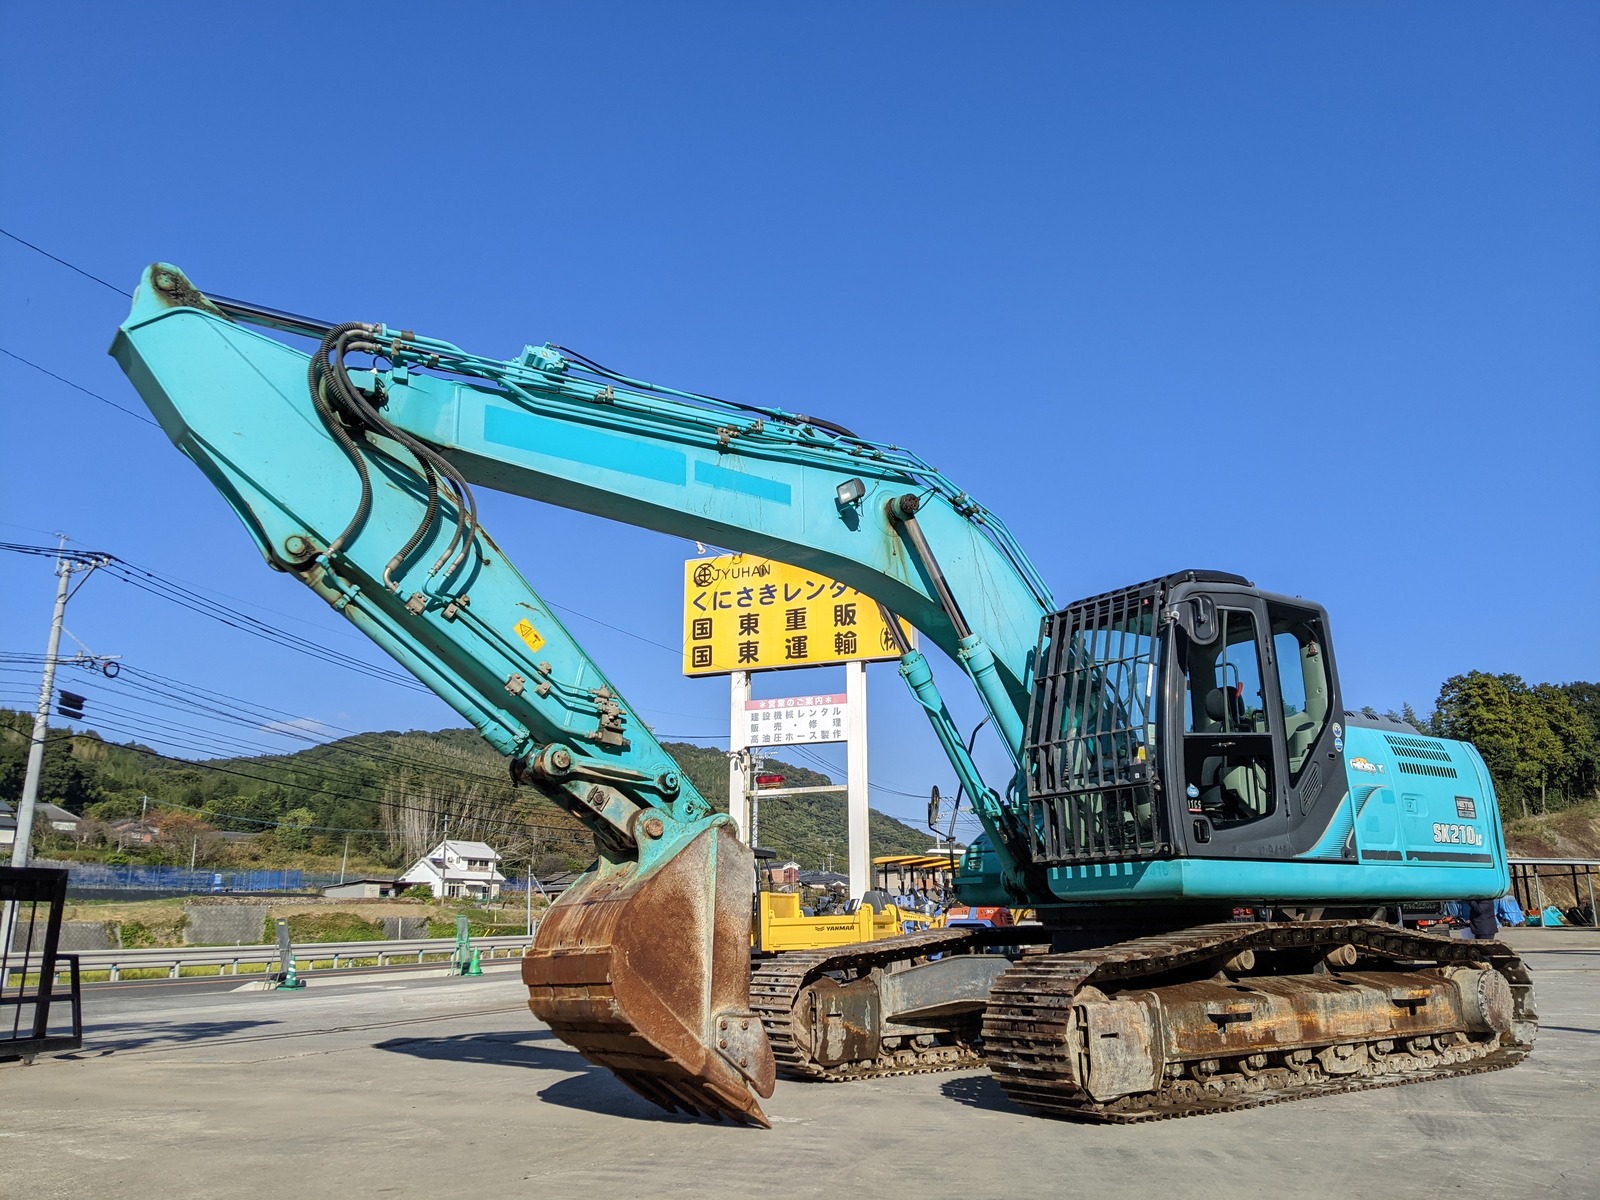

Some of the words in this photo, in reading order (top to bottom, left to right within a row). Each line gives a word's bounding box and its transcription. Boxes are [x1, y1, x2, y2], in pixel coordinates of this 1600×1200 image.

[711, 564, 771, 581] JYUHAN
[692, 580, 860, 611] くにさきレンタ
